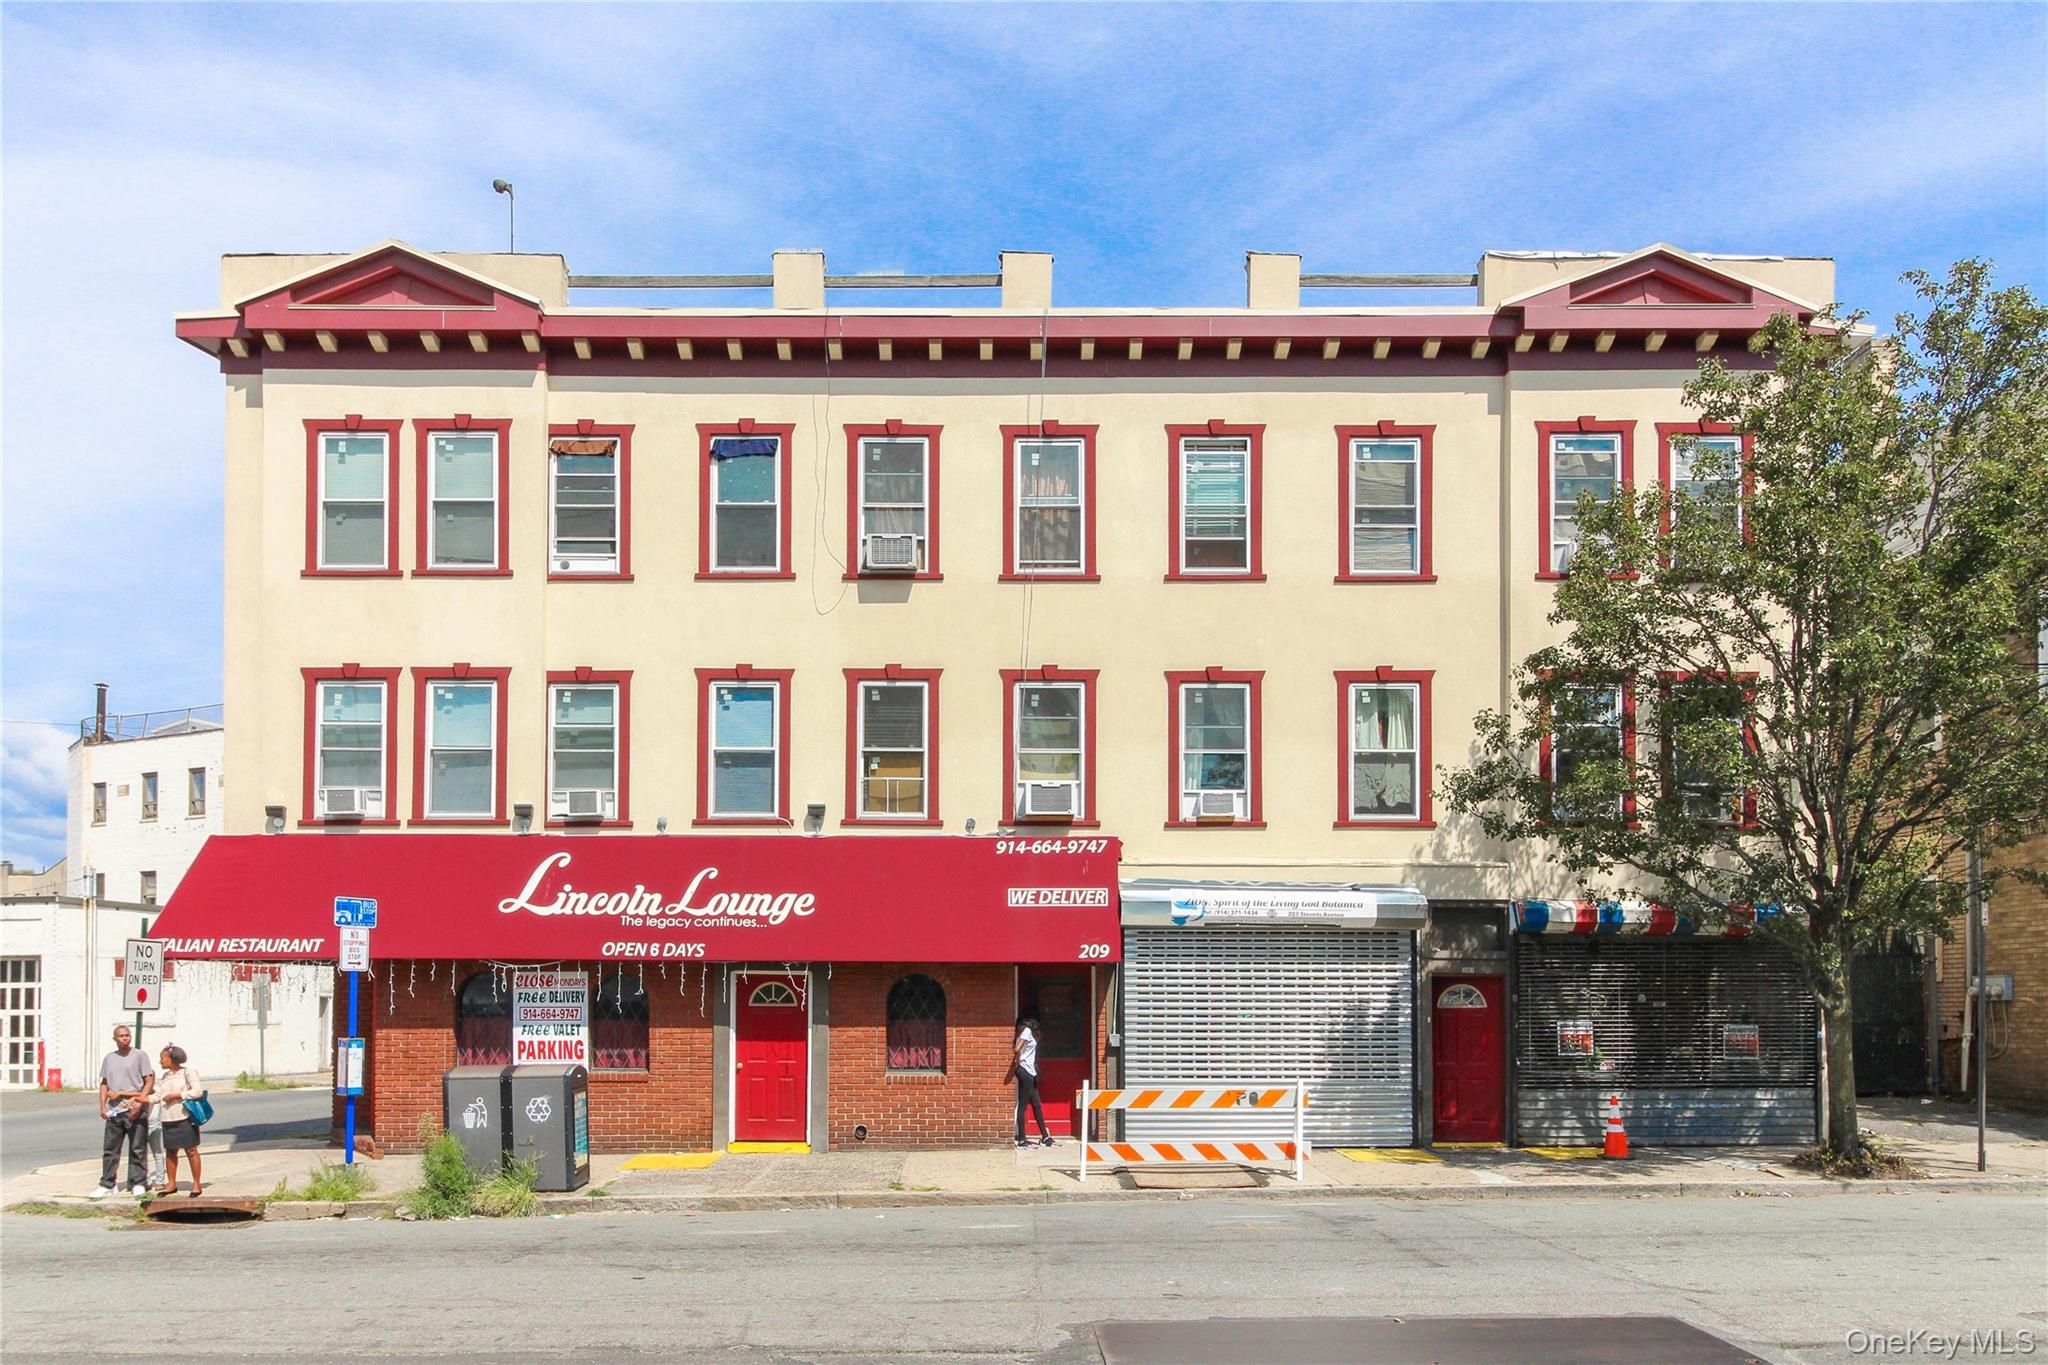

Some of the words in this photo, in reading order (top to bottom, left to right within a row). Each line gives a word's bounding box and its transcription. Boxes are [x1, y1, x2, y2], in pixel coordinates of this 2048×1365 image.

[996, 839, 1107, 854] 914-664-9747
[498, 852, 664, 916] Lincoln
[664, 867, 816, 925] Lounge
[1011, 890, 1038, 904] WE
[1039, 890, 1105, 904] DELIVER
[620, 916, 643, 927] The
[646, 916, 691, 929] legacy
[694, 916, 768, 928] continues...
[350, 931, 360, 939] NO
[136, 945, 153, 958] NO
[160, 938, 215, 953] TALIAN
[217, 938, 324, 953] RESTAURANT
[602, 942, 647, 956] OPEN
[650, 943, 659, 957] 6
[662, 943, 705, 957] DAYS
[1078, 944, 1110, 958] 209
[134, 961, 155, 971] TURN
[128, 974, 140, 985] ON
[142, 975, 158, 985] RED
[516, 974, 554, 987] CLOSE
[517, 991, 546, 1003] FREE
[549, 991, 585, 1003] DELIVERY
[521, 1024, 550, 1036] FREE
[553, 1024, 581, 1036] VALET
[518, 1039, 584, 1060] PARKING
